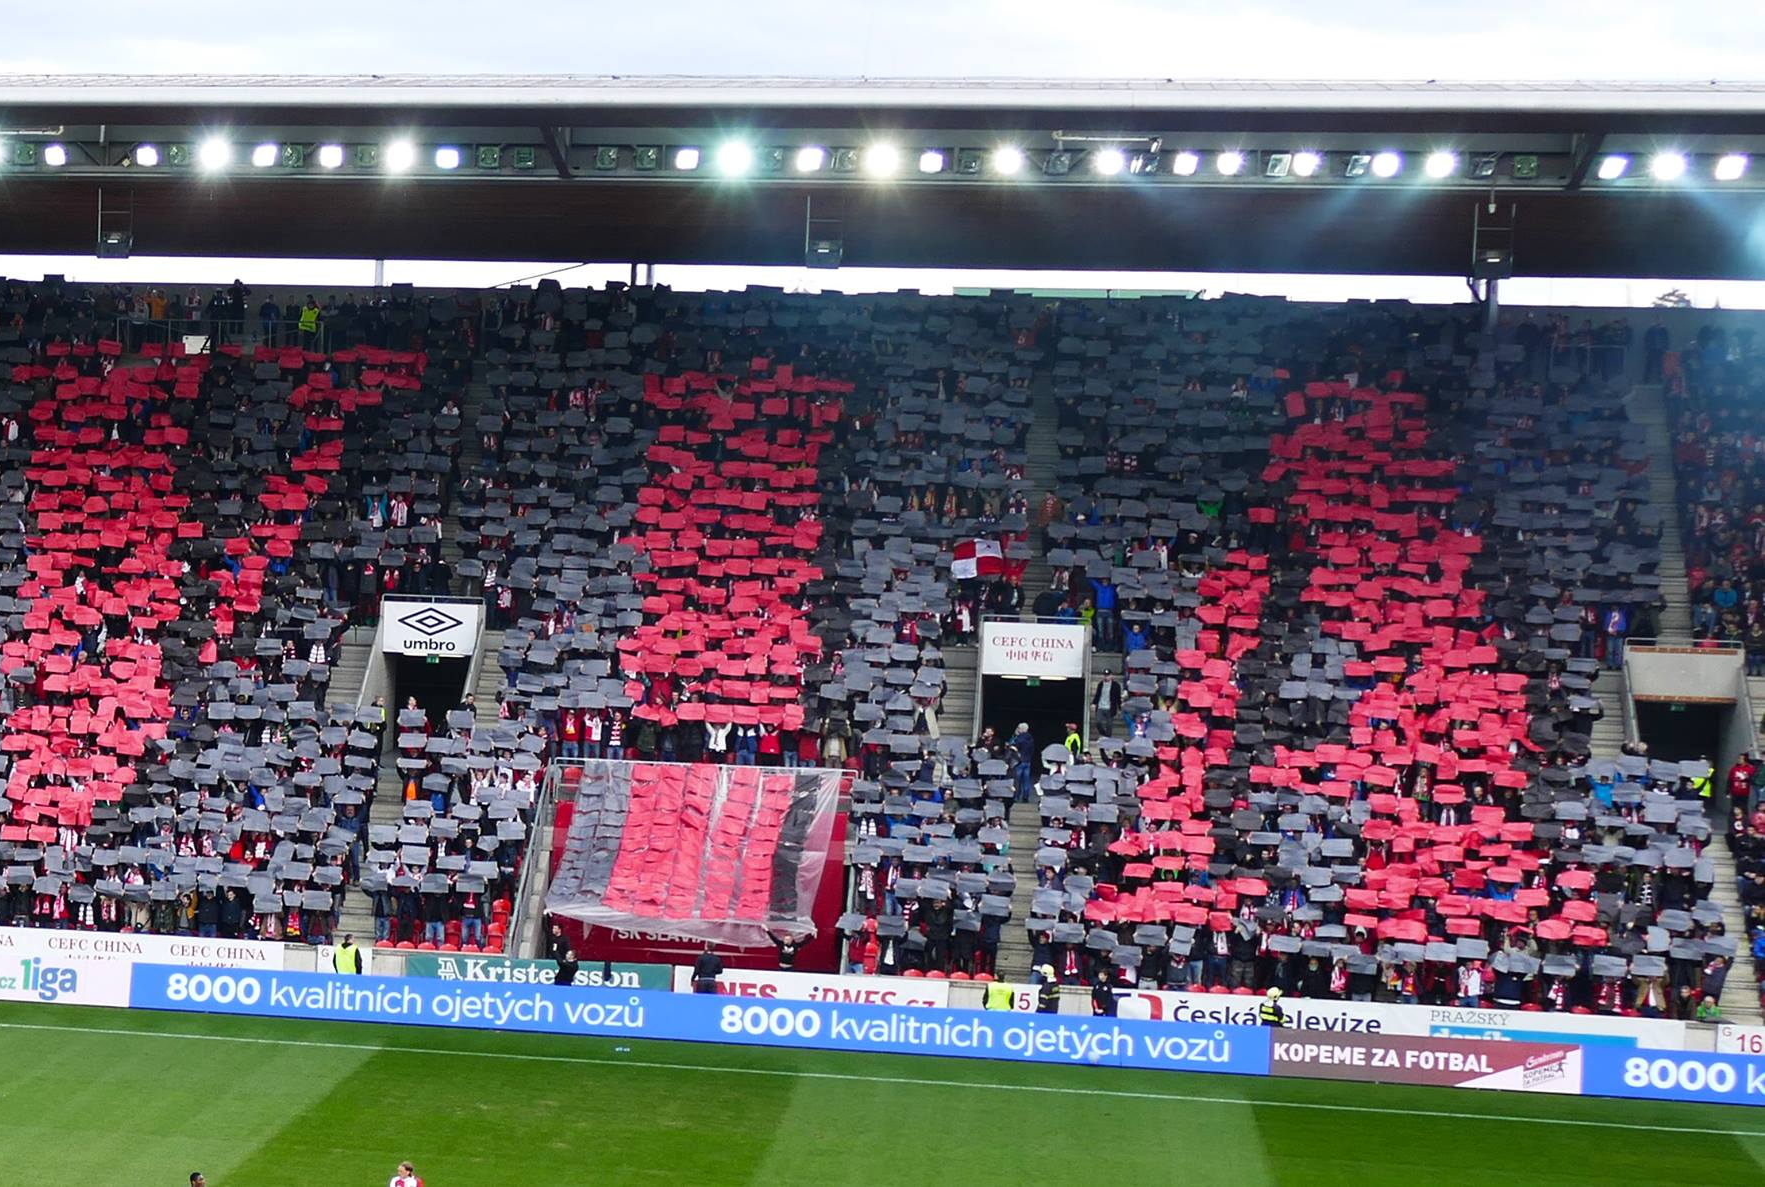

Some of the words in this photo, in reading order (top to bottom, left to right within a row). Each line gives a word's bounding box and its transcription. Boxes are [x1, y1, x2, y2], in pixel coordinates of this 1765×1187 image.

[403, 638, 455, 651] umbro
[992, 636, 1028, 646] CEFC
[1032, 638, 1074, 649] CHINA
[48, 937, 89, 951] CEFC
[93, 939, 142, 954] CHINA
[170, 944, 211, 958] CEFC
[216, 945, 266, 960] CHINA
[322, 948, 330, 958] G
[464, 958, 641, 988] Kristesson
[694, 981, 778, 999] NES
[809, 986, 936, 1008] iDNEScz
[166, 973, 261, 1005] 8000
[270, 978, 422, 1014] kvalitních
[432, 989, 553, 1025] ojetých
[564, 996, 644, 1027] vozů
[1173, 1000, 1257, 1026] Česká
[1282, 1010, 1381, 1034] elevize
[1430, 1009, 1511, 1026] PRAŽSKÝ
[720, 1004, 820, 1038] 8000
[831, 1010, 992, 1048] kvalitních
[1003, 1021, 1133, 1059] ojetých
[1144, 1030, 1229, 1062] vozů
[1723, 1027, 1732, 1036] G
[1736, 1033, 1763, 1054] 16
[1274, 1042, 1365, 1066] KOPEME
[1370, 1048, 1400, 1068] ZA
[1406, 1050, 1495, 1073] FOTBAL
[1624, 1057, 1737, 1093] 8000
